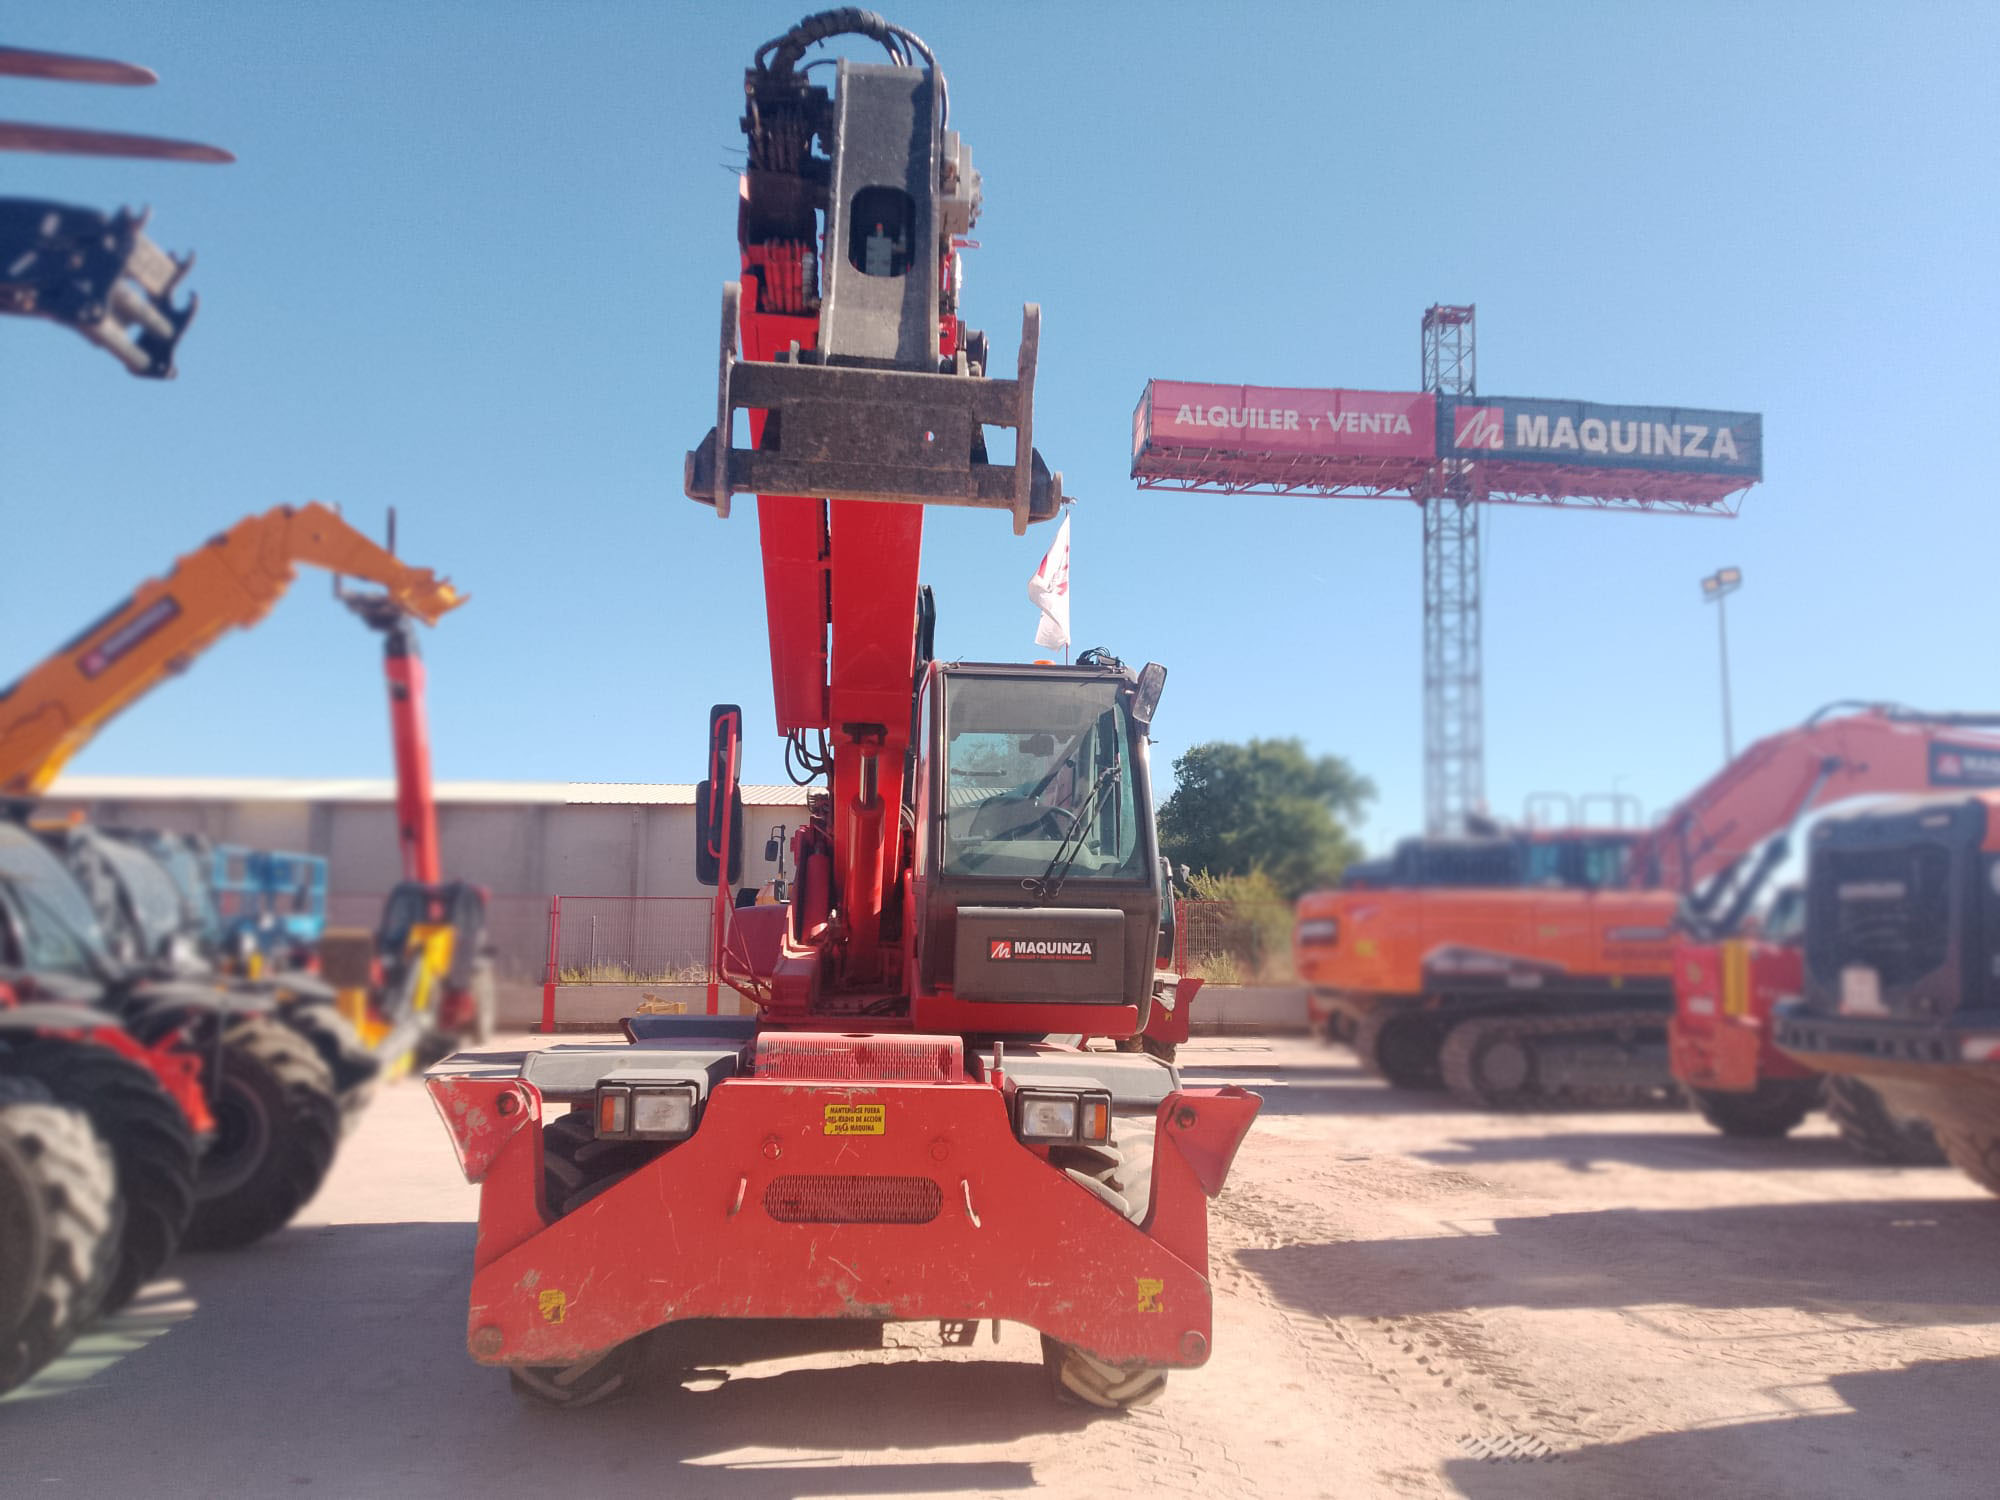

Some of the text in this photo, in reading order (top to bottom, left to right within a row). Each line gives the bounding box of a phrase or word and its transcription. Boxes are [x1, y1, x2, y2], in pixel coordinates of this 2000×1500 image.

[1175, 404, 1300, 431] ALQUILER
[1328, 410, 1412, 435] VENTA
[1516, 414, 1738, 461] MAQUINZA
[1014, 942, 1092, 955] MAQUINZA
